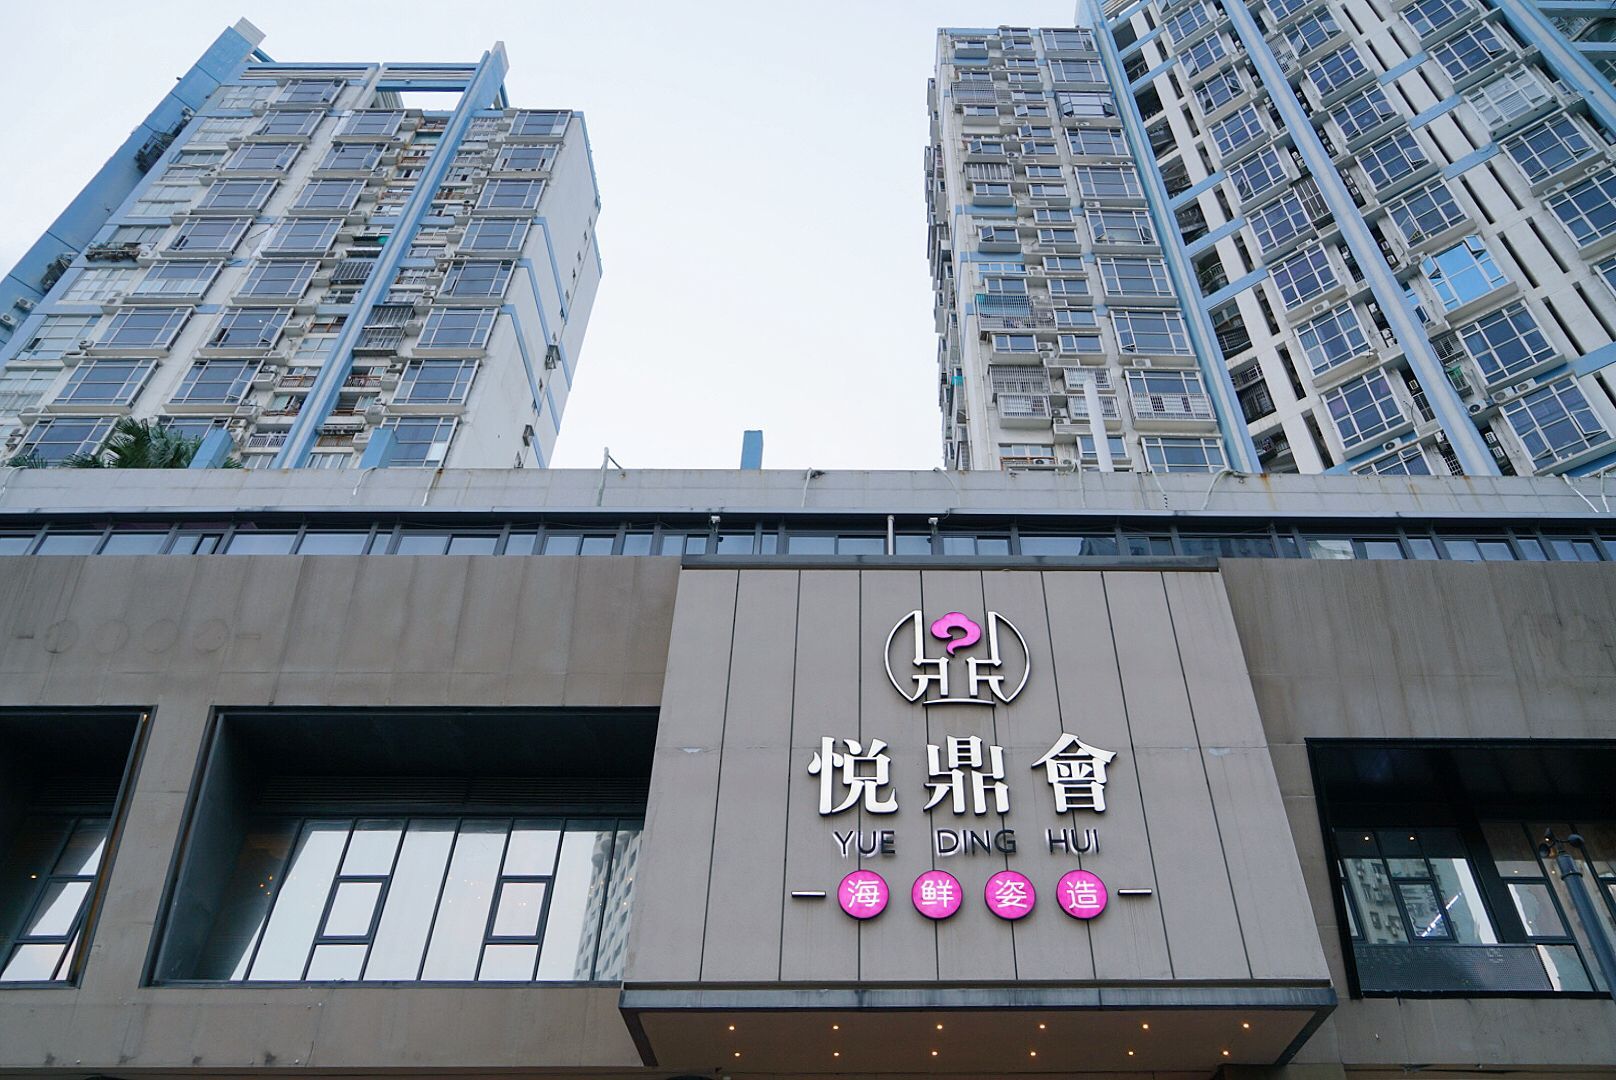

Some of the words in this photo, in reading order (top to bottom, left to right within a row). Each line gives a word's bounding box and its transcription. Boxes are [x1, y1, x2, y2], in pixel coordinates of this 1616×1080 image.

[807, 733, 1118, 815] 悦鼎會
[833, 829, 897, 857] YUE
[935, 829, 1017, 857] DING
[1046, 828, 1100, 856] HUI
[846, 877, 1101, 910] 海鲜姿造
